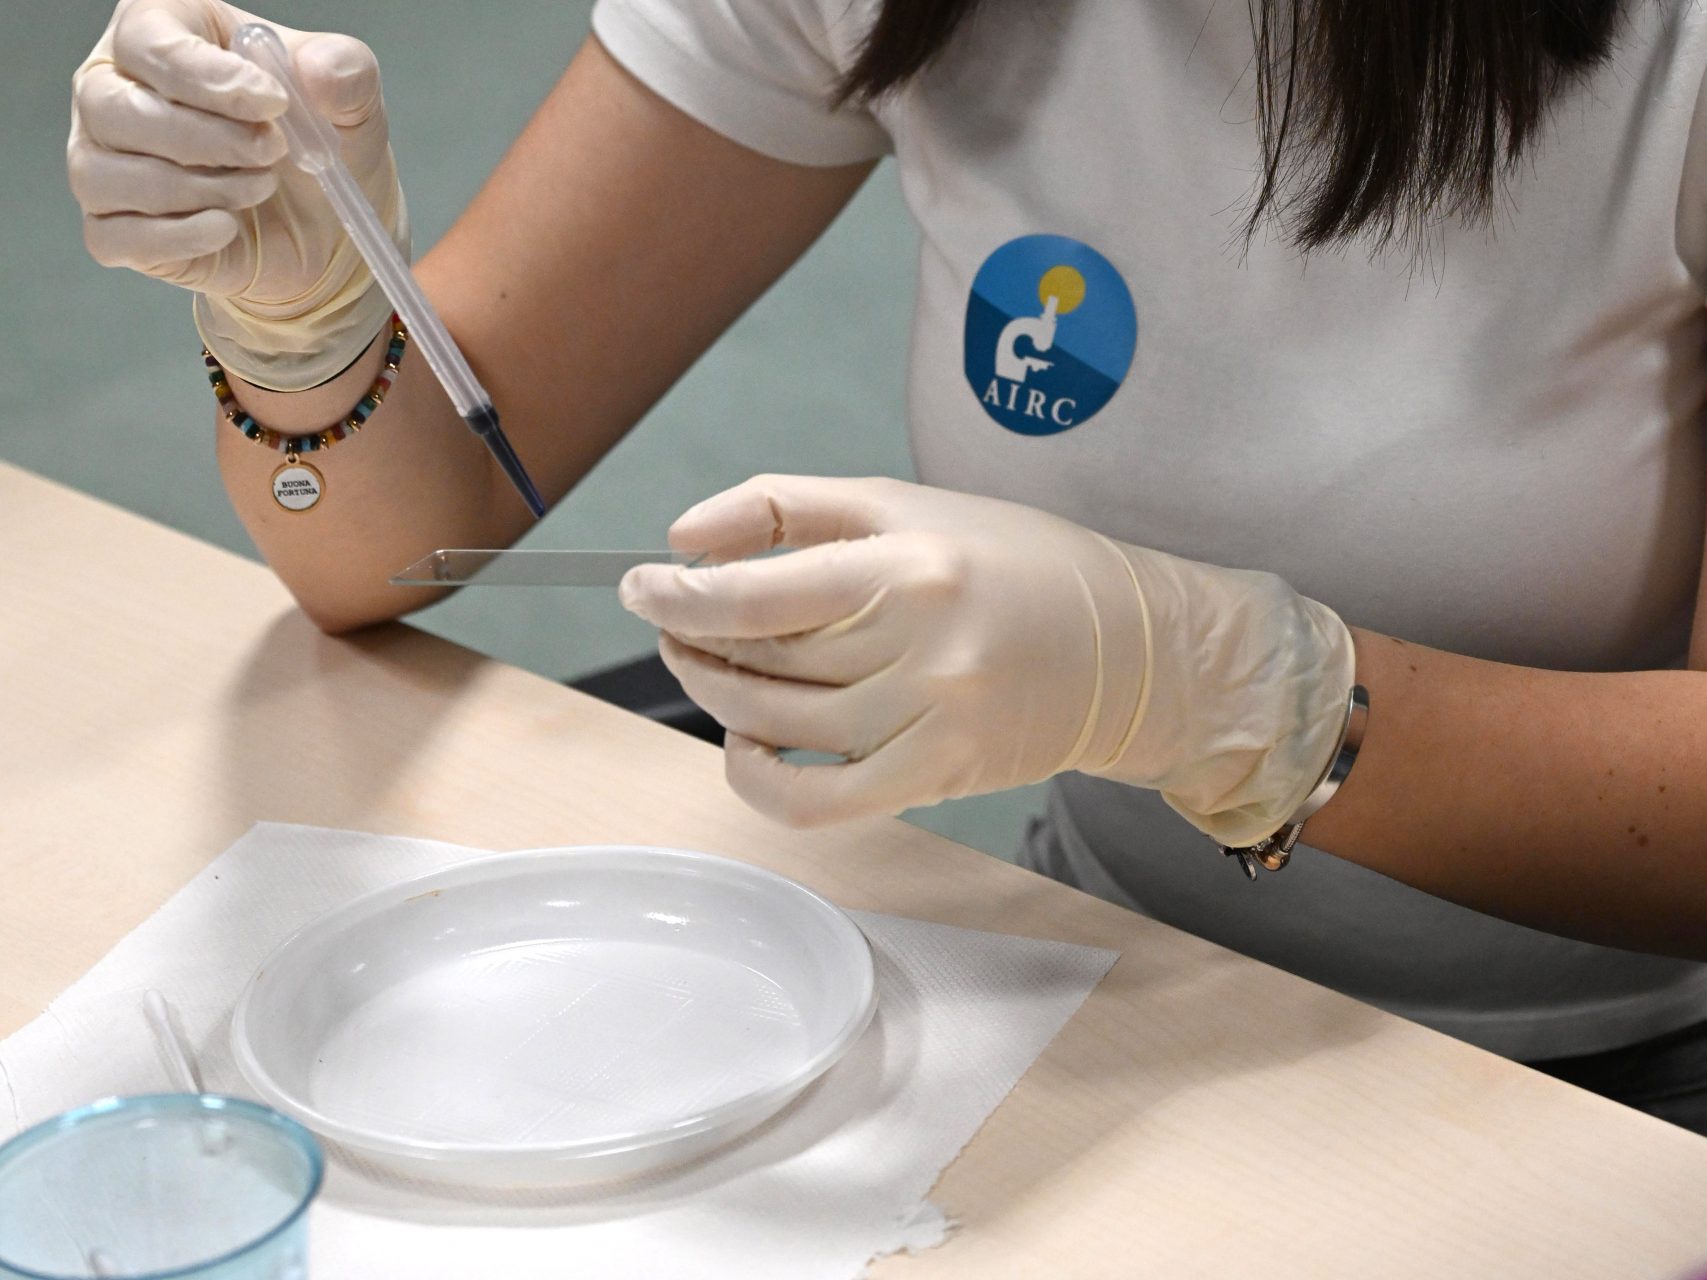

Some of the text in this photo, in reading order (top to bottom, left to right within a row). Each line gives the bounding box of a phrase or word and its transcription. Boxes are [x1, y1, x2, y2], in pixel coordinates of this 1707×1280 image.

[983, 379, 1076, 426] AIRC
[281, 480, 311, 488] BUONA
[277, 488, 318, 497] FORTUNA
